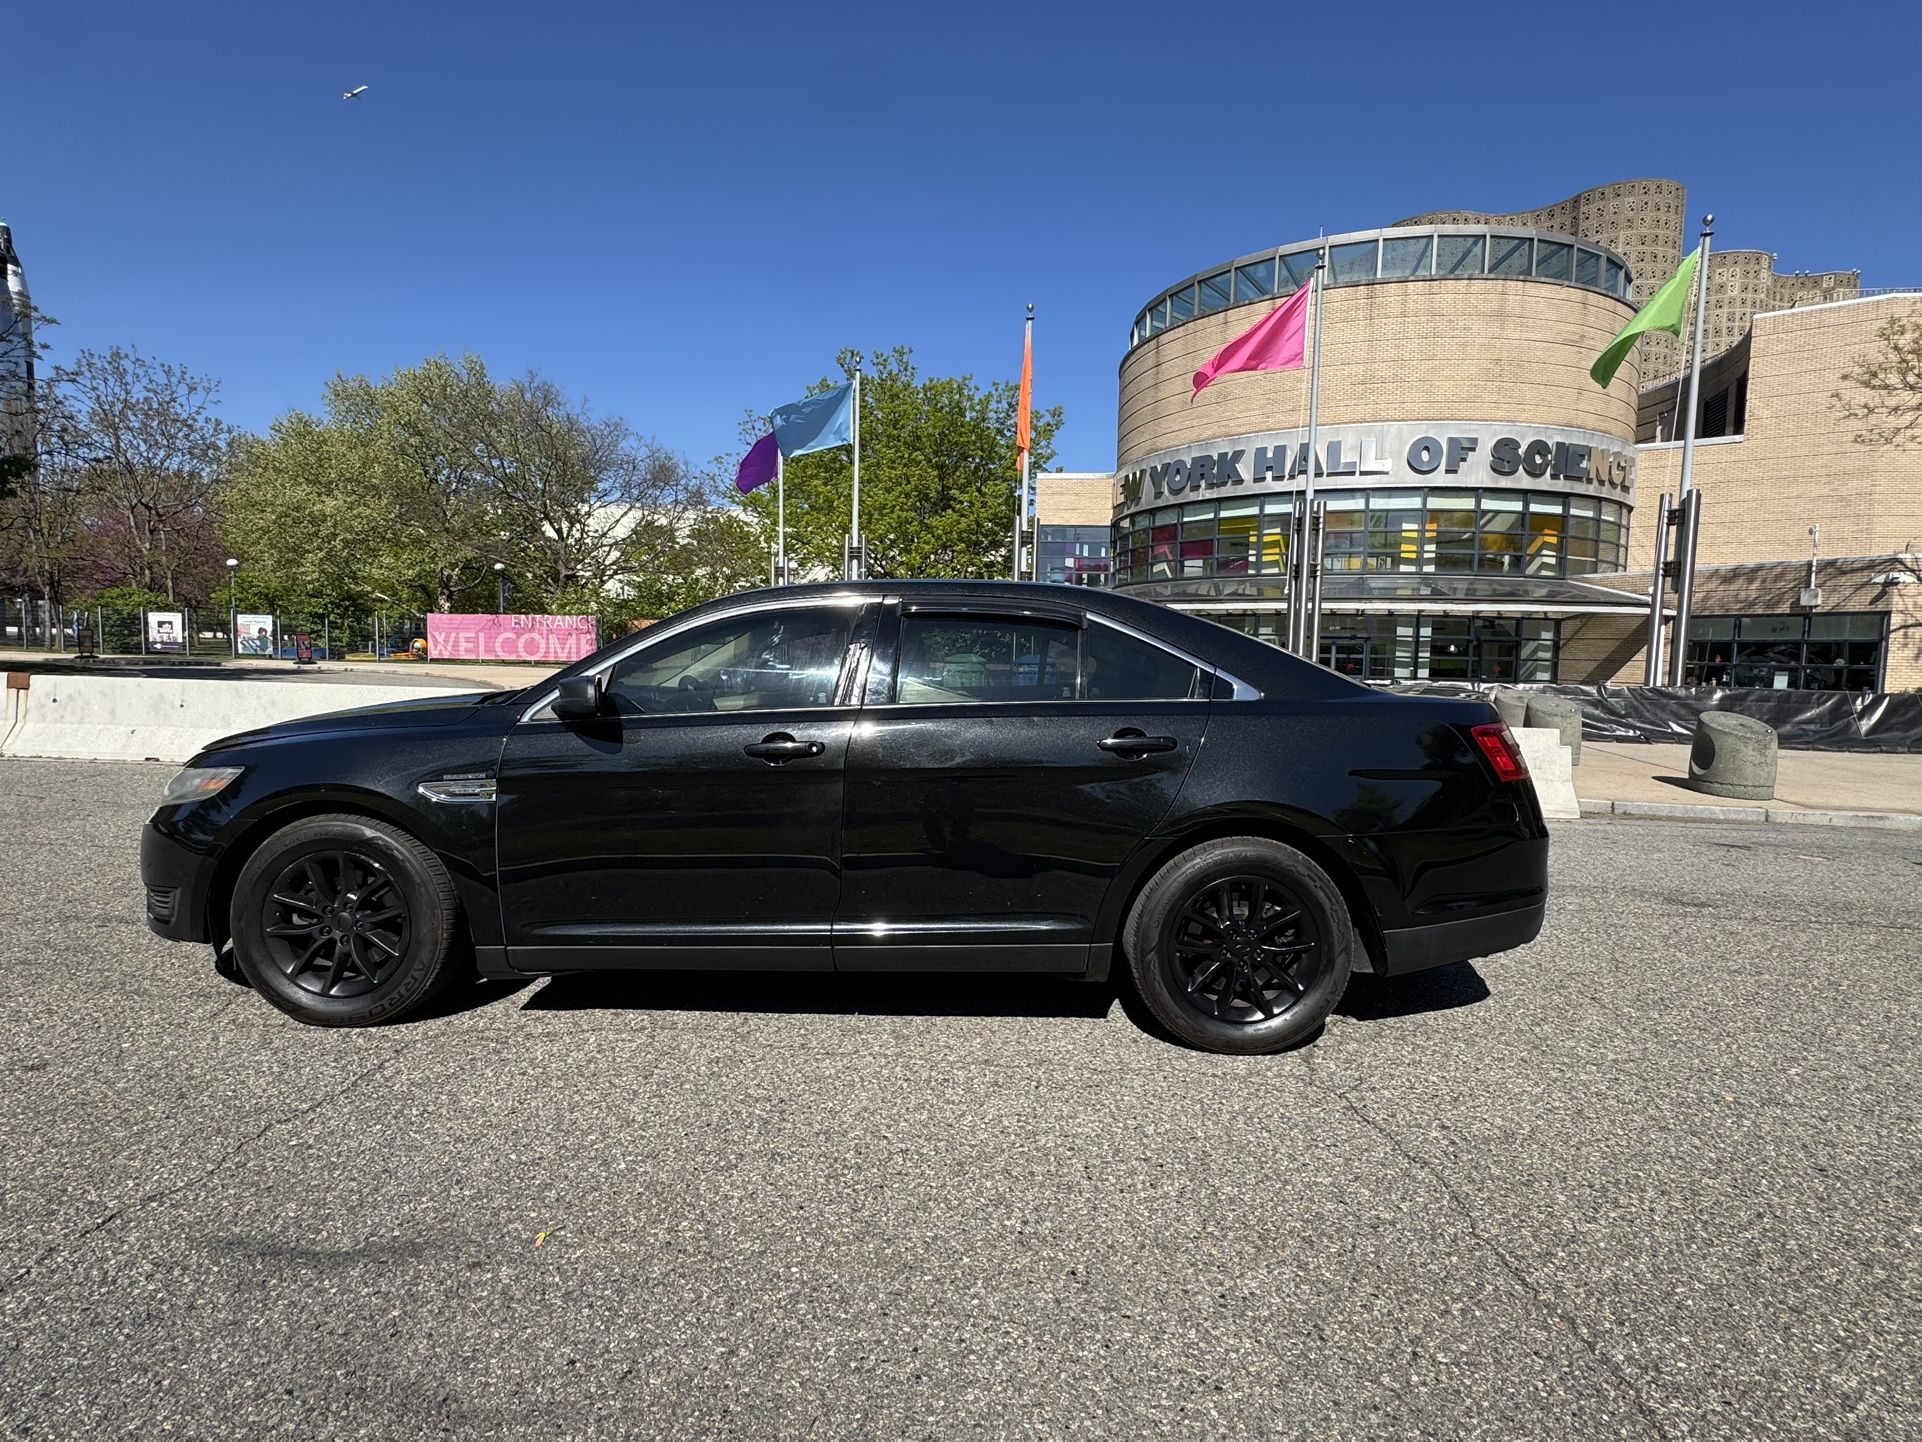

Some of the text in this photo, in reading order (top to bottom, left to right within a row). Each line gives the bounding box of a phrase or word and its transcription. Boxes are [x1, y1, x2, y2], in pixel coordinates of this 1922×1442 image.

[1114, 436, 1636, 509] EW YORK HALL OF SCIENCE
[511, 614, 597, 629] ENTRANCE
[429, 631, 597, 661] WELCOME
